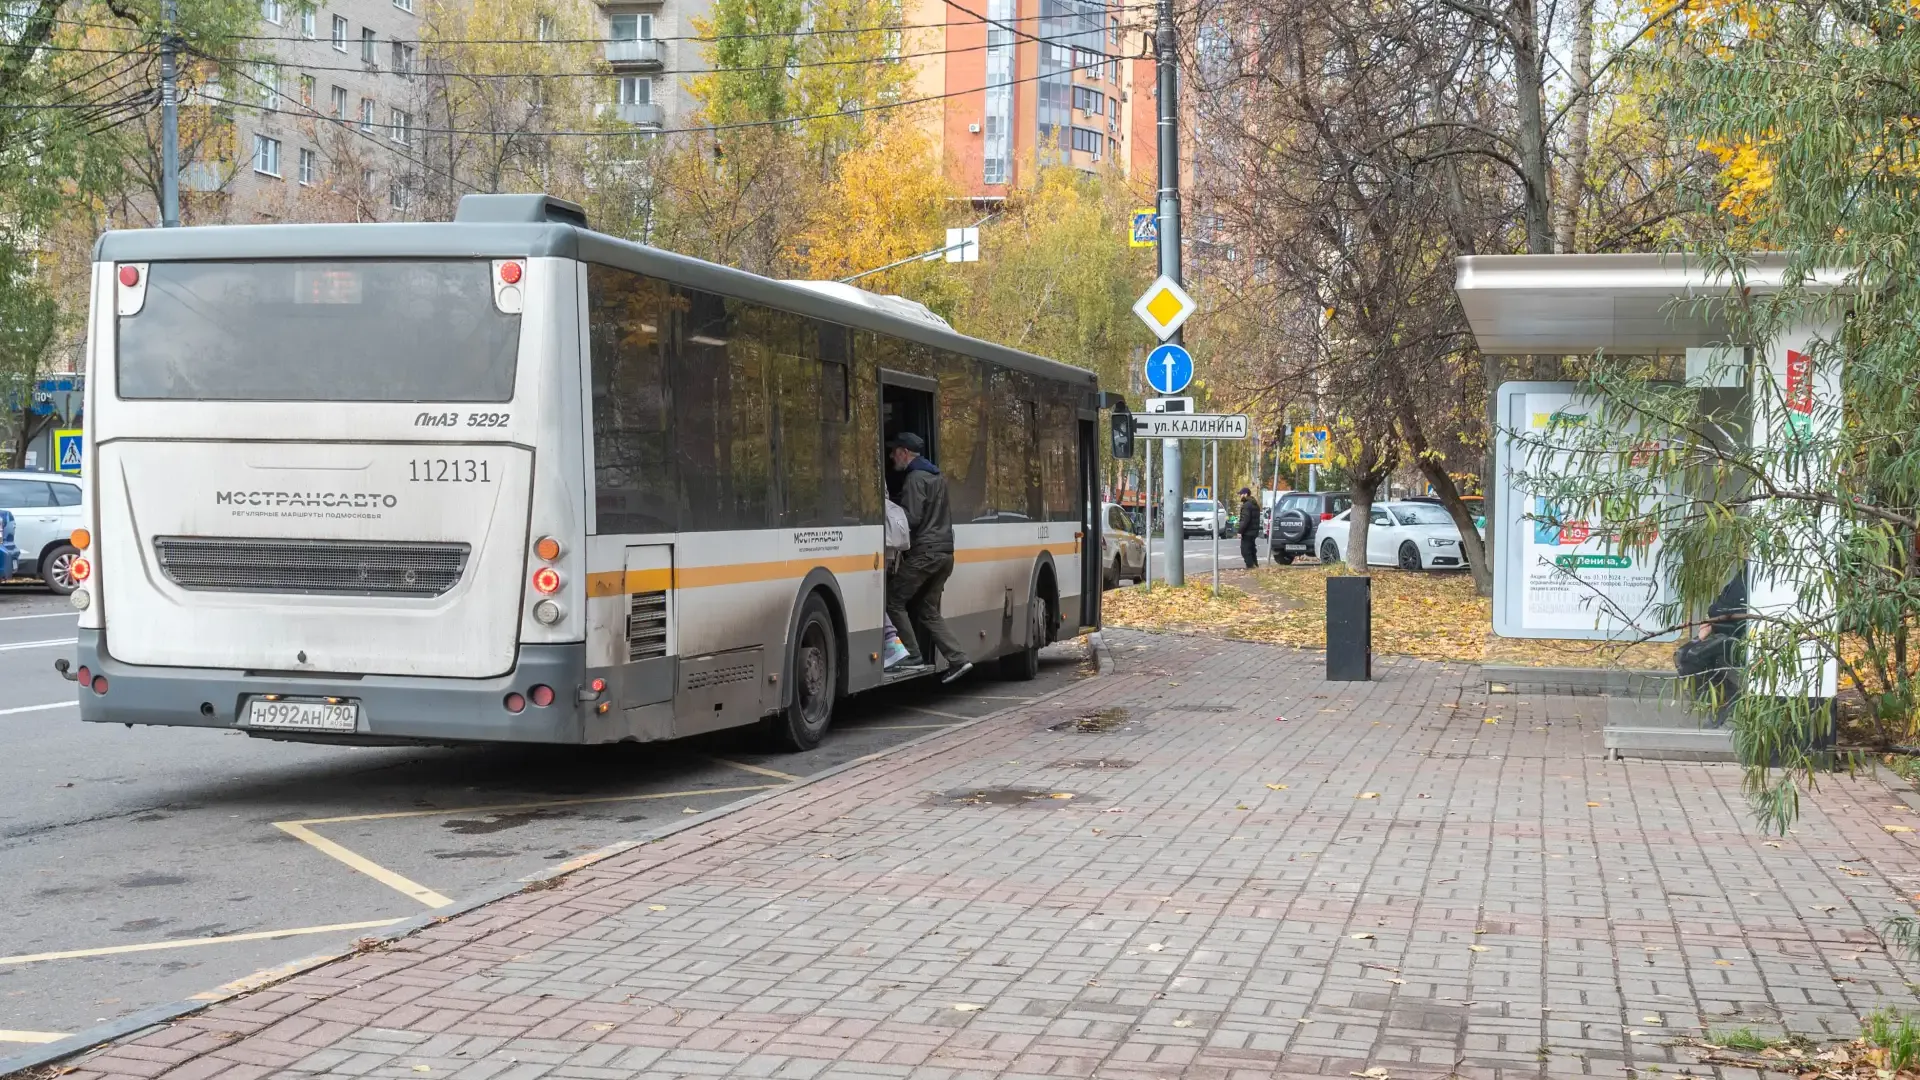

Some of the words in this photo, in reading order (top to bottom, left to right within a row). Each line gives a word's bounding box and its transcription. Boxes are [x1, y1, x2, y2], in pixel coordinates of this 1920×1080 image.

[467, 413, 510, 428] 5292
[409, 459, 491, 483] 112131
[216, 491, 397, 508] МОСТРАНСАВТО
[231, 510, 279, 518] РЕГУЛЯРНЫЕ
[793, 530, 843, 544] МОСТРАНСАВТО
[325, 706, 351, 721] 790
